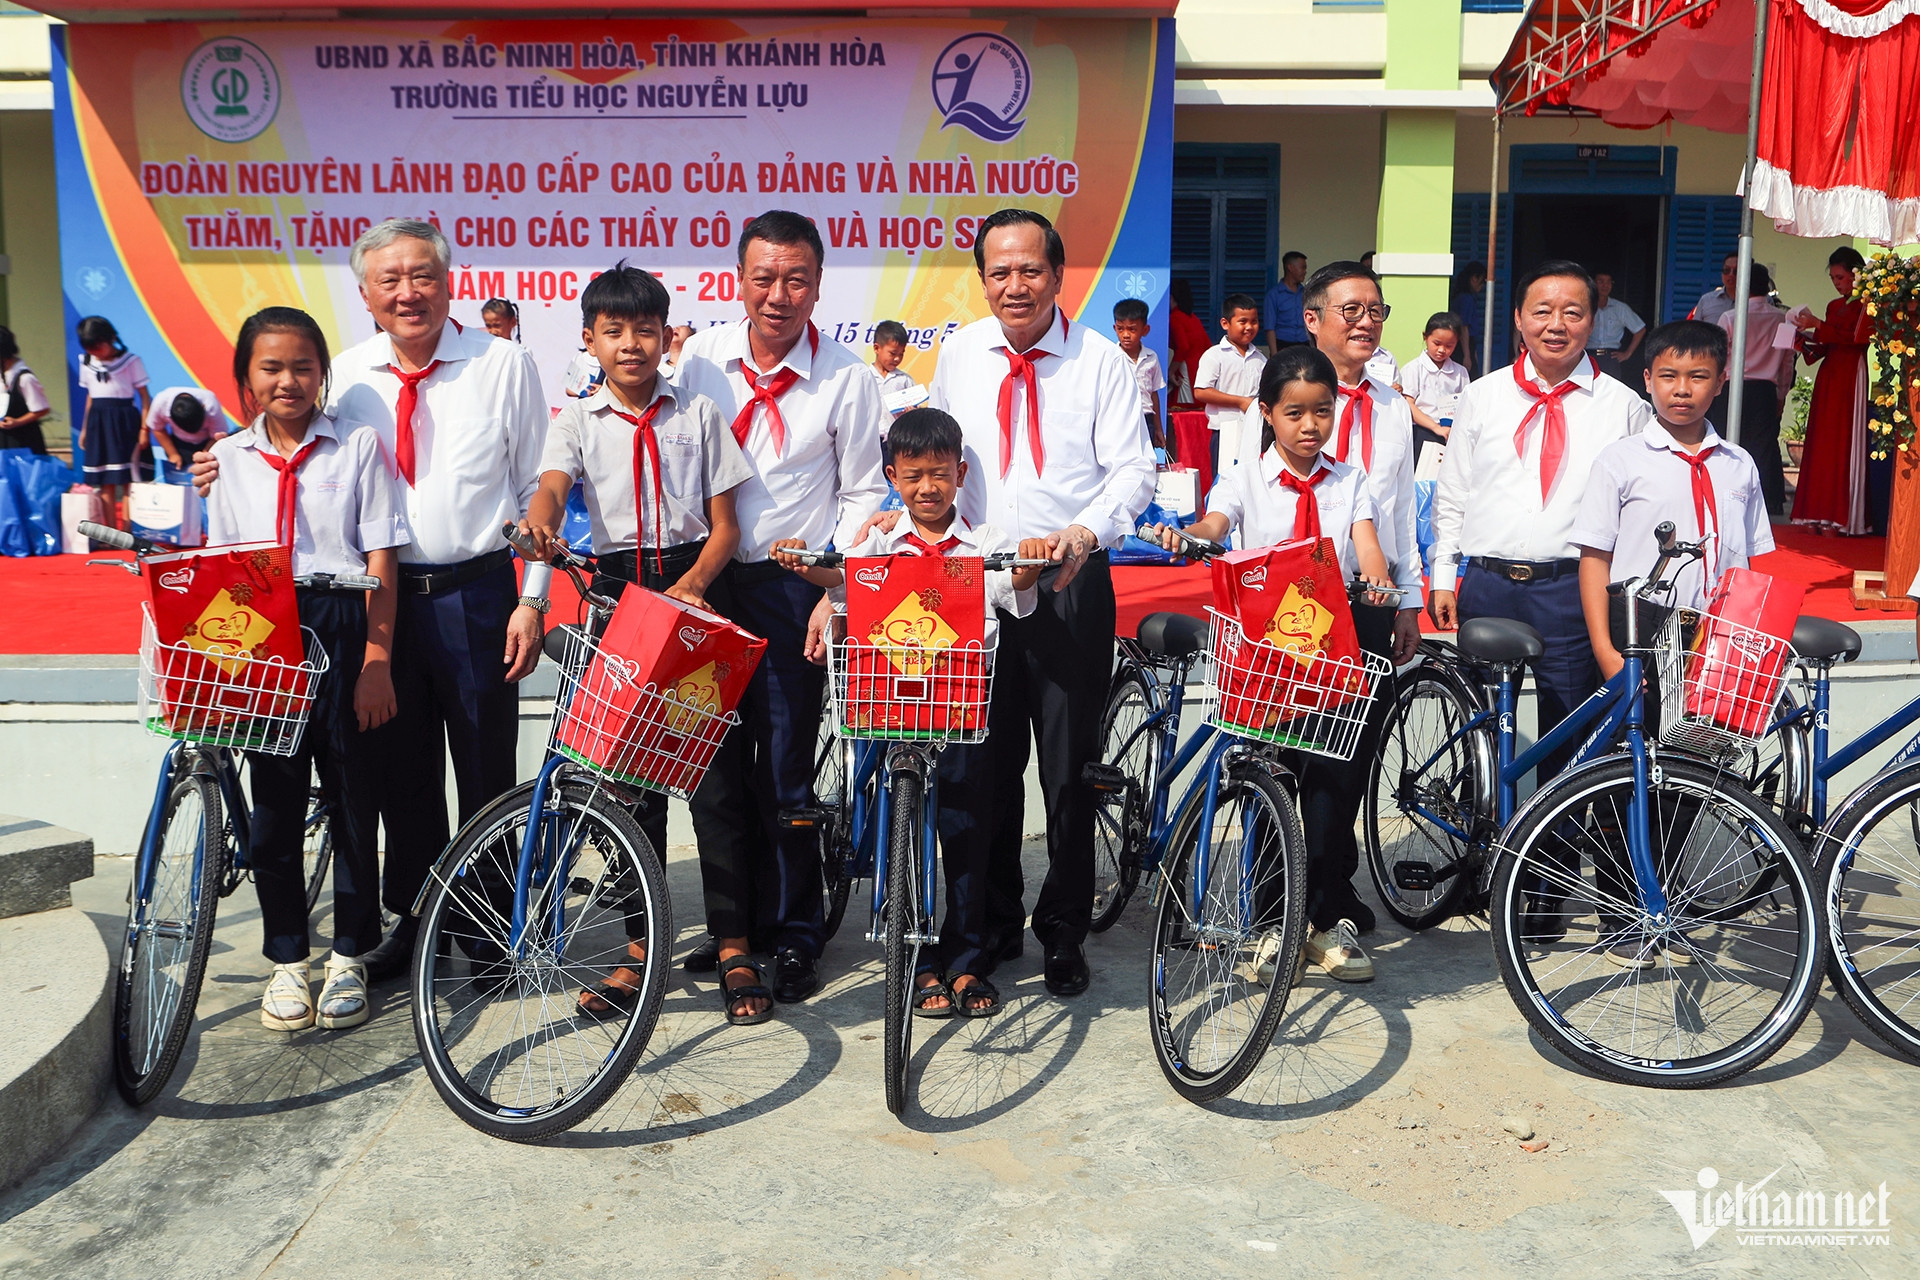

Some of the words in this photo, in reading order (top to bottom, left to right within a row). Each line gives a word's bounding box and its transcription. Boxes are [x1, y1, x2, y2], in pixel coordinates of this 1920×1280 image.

[315, 45, 388, 69] UBND
[398, 39, 433, 68] XÃ
[443, 36, 496, 68] BẮC
[506, 44, 572, 68] NINH
[583, 38, 645, 71] HÒA,
[654, 36, 716, 67] TỈNH
[726, 38, 820, 67] KHÁNH
[830, 37, 885, 67] HÒA
[391, 80, 496, 108] TRƯỜNG
[506, 74, 563, 108] TIỂU
[574, 83, 628, 114] HỌC
[638, 75, 747, 108] NGUYỄN
[758, 82, 808, 113] LỰU
[144, 157, 227, 193] ĐOÀN
[239, 157, 360, 193] NGUYÊN
[374, 157, 452, 193] LÃNH
[464, 162, 525, 199] ĐẠO
[538, 152, 598, 193] CẤP
[611, 163, 672, 193] CAO
[684, 152, 746, 193] CỦA
[758, 152, 845, 193] ĐẢNG
[858, 156, 897, 193] VÀ
[910, 156, 976, 194] NHÀ
[988, 156, 1076, 195] NƯỚC
[187, 212, 281, 250] THĂM,
[455, 217, 516, 247] CHO
[529, 211, 588, 247] CÁC
[601, 206, 677, 247] THẦY
[690, 210, 731, 248] CÔ
[828, 211, 868, 248] VÀ
[880, 217, 943, 254] HỌC
[517, 271, 578, 307] HỌC
[698, 271, 744, 302] 20
[834, 322, 860, 343] 15
[865, 322, 938, 349] tng
